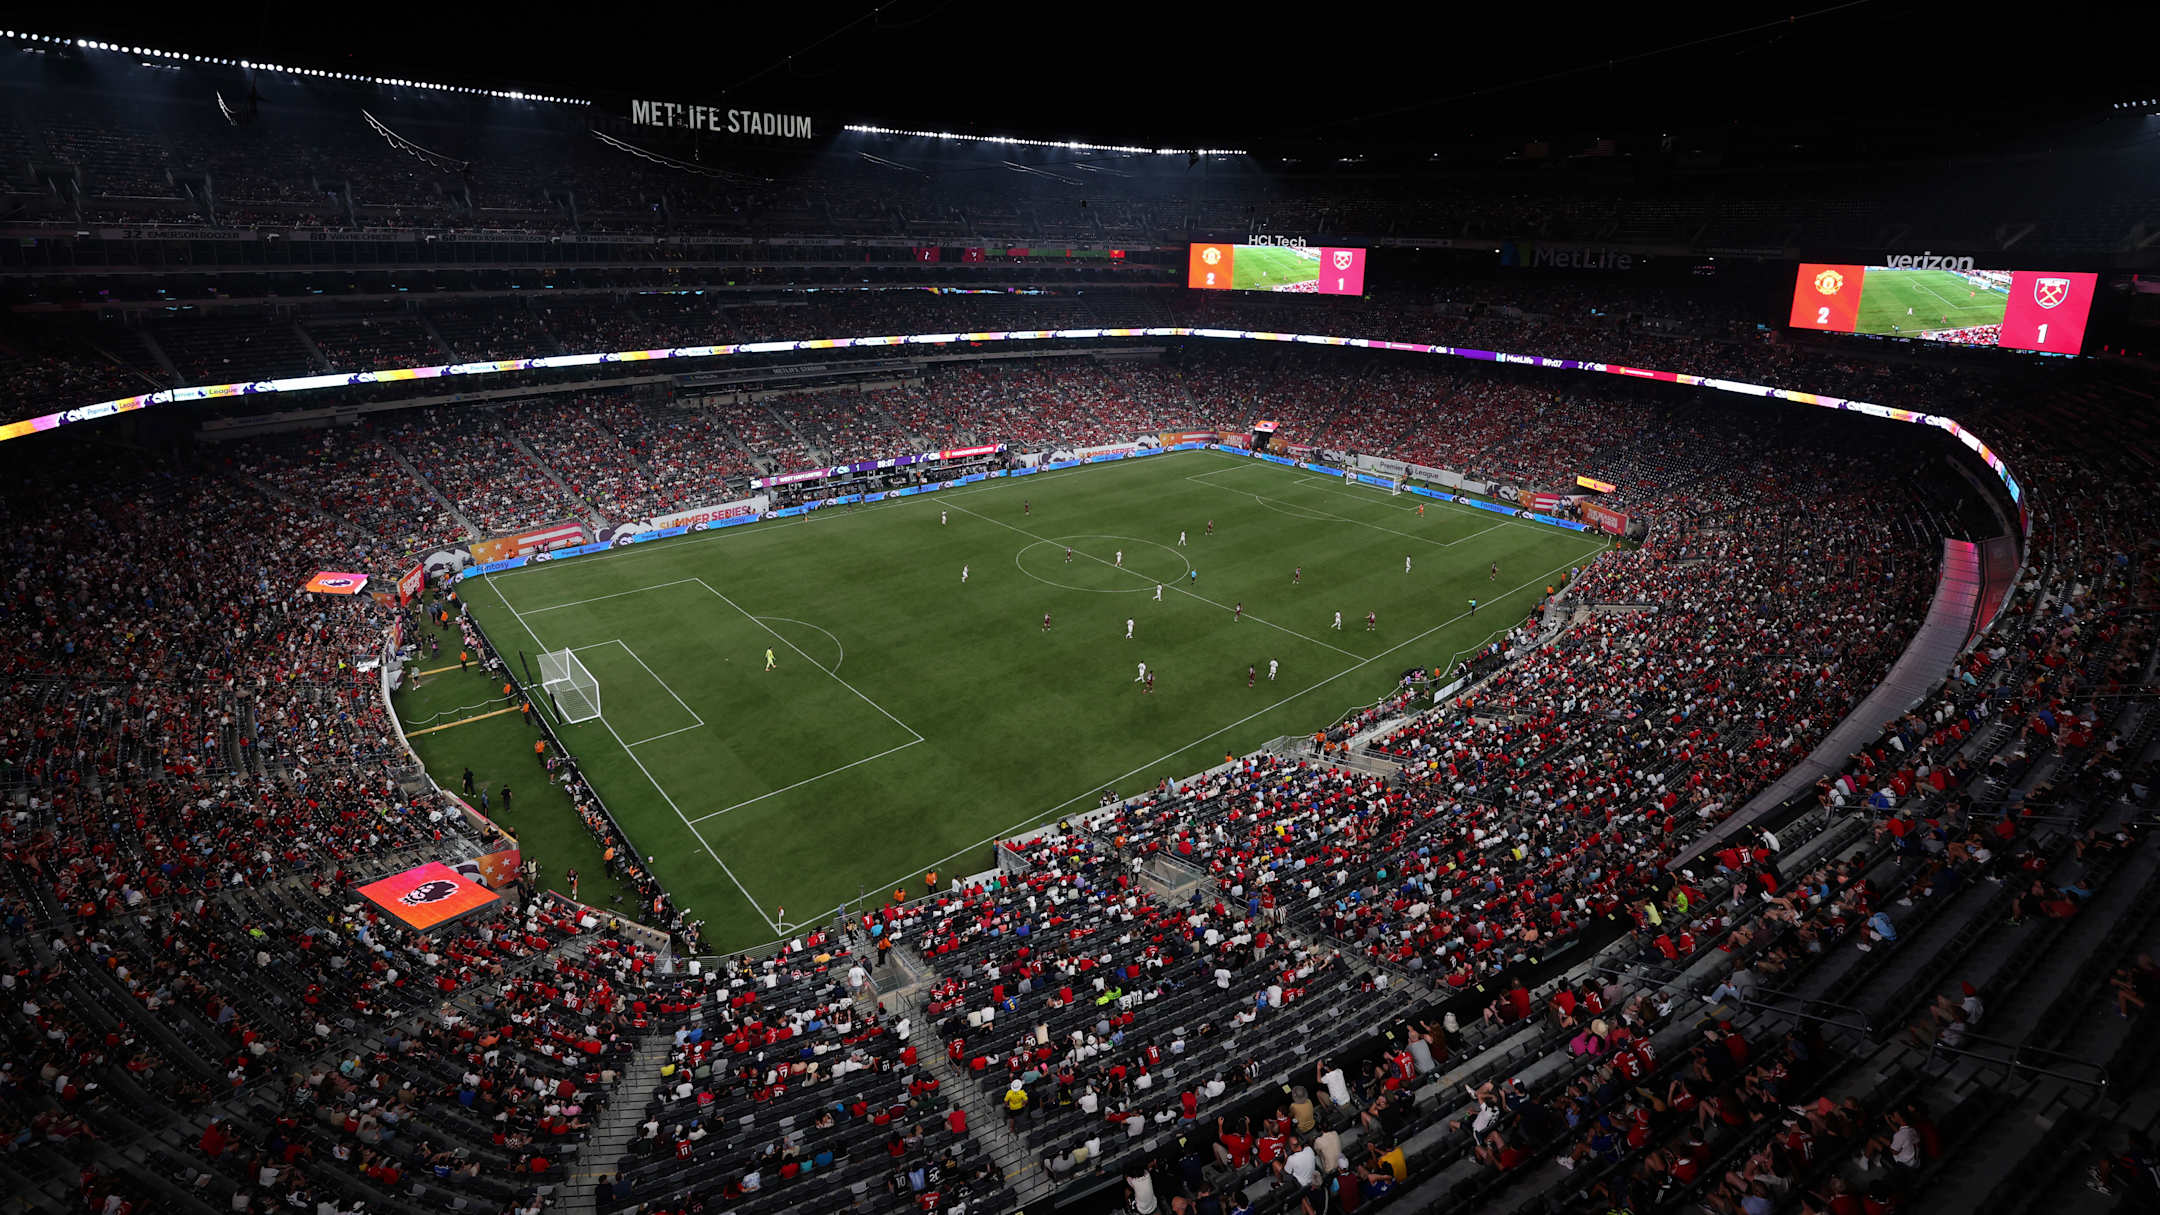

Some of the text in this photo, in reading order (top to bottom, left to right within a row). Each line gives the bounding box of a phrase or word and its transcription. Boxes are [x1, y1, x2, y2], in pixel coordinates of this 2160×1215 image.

[727, 108, 812, 140] STADIUM
[1248, 234, 1307, 247] HCLTech
[1533, 246, 1633, 271] MetLife
[1886, 250, 1976, 271] verizon
[1206, 272, 1216, 286] 2
[1337, 277, 1345, 291] 1
[1816, 306, 1831, 324] 2
[2036, 323, 2049, 344] 1
[1506, 354, 1535, 365] MetLife
[1577, 361, 1584, 370] 2
[209, 386, 238, 396] League
[910, 455, 917, 464] 2
[1379, 461, 1440, 479] Premier League
[659, 505, 750, 530] SUMMER SERIES
[720, 517, 746, 526] Fantasy
[476, 561, 509, 573] Fantasy
[1643, 1045, 1656, 1062] 18
[1628, 1059, 1639, 1077] 3
[896, 1175, 906, 1189] 10
